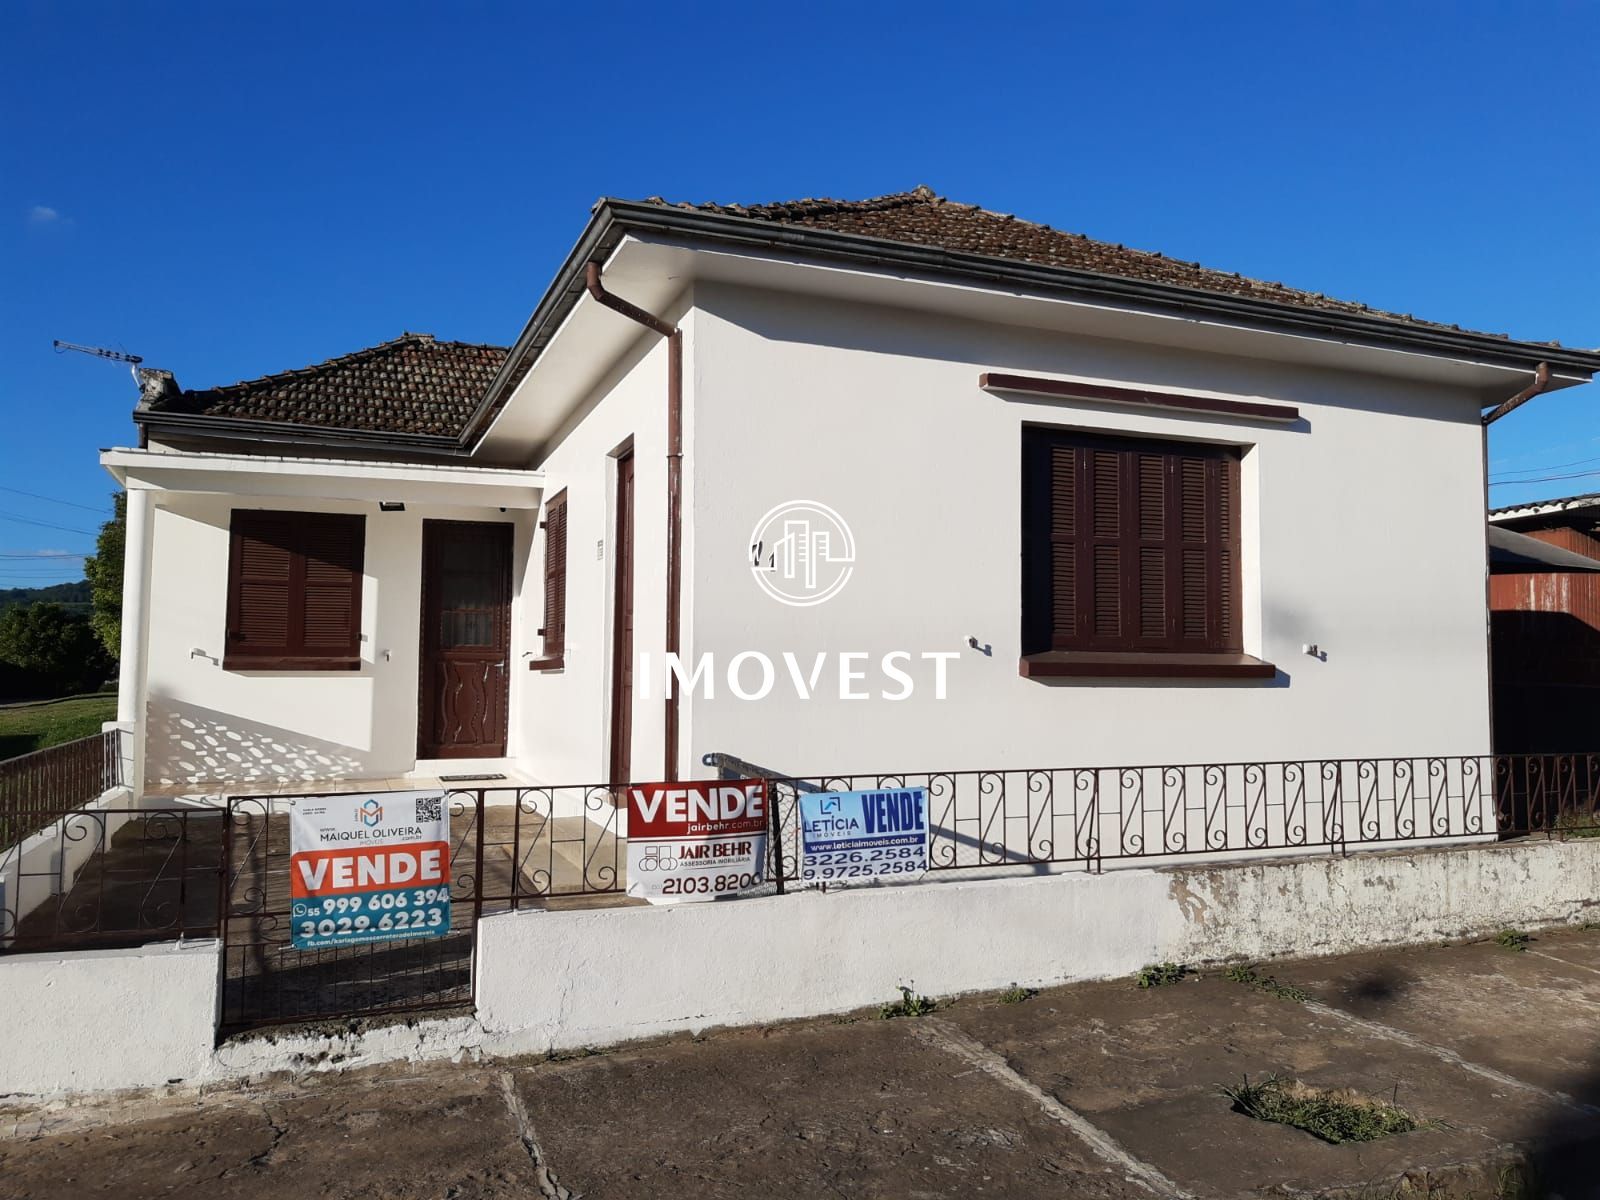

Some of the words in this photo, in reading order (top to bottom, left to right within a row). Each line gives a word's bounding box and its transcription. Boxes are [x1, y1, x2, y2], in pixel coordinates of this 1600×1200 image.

[632, 785, 763, 824] VENDE
[861, 791, 925, 834] VENDE
[320, 830, 370, 842] MAIQUEL
[372, 827, 422, 839] OLIVEIRA
[687, 820, 763, 834] jairbehr.com.br
[804, 815, 860, 833] LETÍCIA
[678, 844, 710, 860] JAIR
[712, 841, 752, 857] BEHR
[803, 846, 925, 867] 3226.2584
[298, 849, 441, 891] VENDE
[803, 860, 928, 881] 9.9725.2584
[307, 907, 321, 917] 55
[323, 896, 362, 915] 999
[368, 892, 408, 911] 606
[413, 887, 449, 907] 394
[300, 908, 443, 938] 3029.6223
